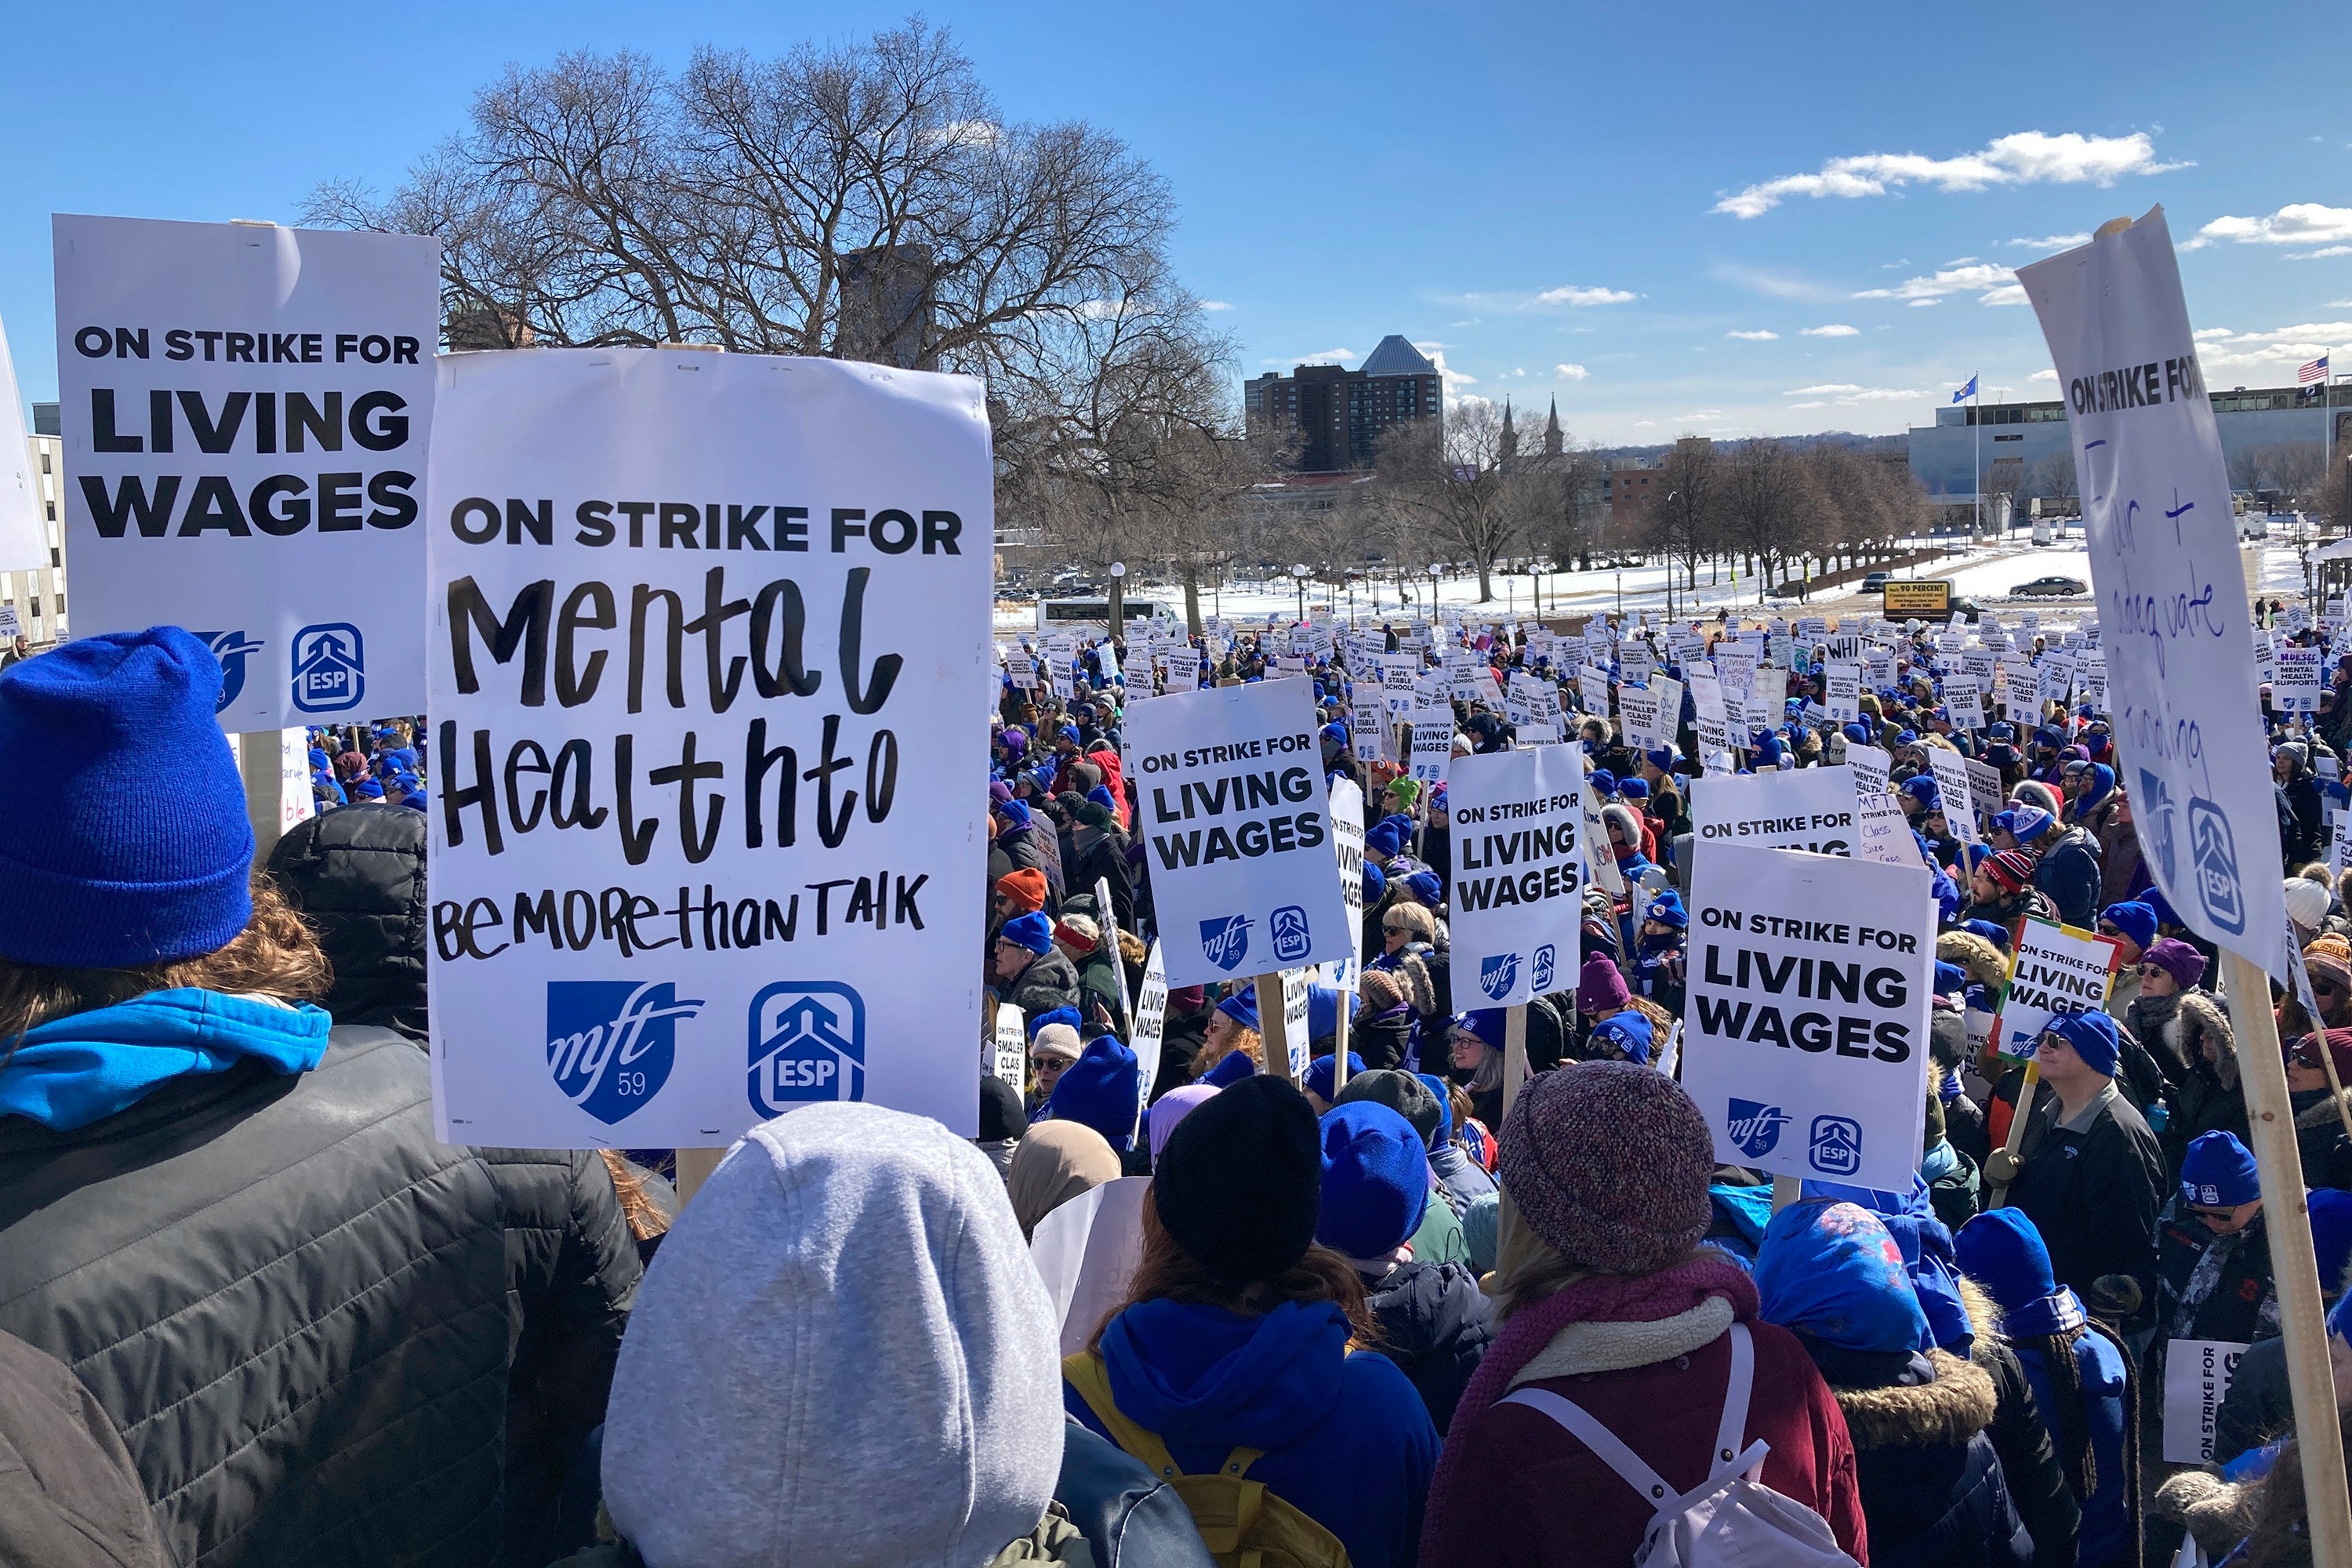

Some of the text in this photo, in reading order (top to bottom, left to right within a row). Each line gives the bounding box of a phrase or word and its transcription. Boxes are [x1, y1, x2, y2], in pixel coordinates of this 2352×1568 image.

[74, 326, 419, 365] ON STRIKE FOR
[2071, 374, 2098, 416] ON
[2096, 361, 2162, 412] STRIKE
[91, 389, 408, 453] LIVING
[78, 471, 418, 538] WAGES
[450, 498, 962, 556] ON STRIKE FOR
[448, 567, 903, 715] Mental
[1053, 665, 1070, 673] LIVING
[1053, 672, 1072, 681] WAGES
[1391, 670, 1409, 678] SAFE,
[308, 670, 347, 690] ESP
[2007, 679, 2038, 690] SMALLER
[2012, 687, 2034, 696] CLASS
[2013, 694, 2033, 703] SIZES
[1621, 703, 1657, 715] SMALLER
[1627, 712, 1653, 721] CLASS
[1356, 717, 1376, 726] STABLE
[1629, 719, 1652, 728] SIZES
[1746, 715, 1766, 724] LIVING
[1414, 731, 1449, 740] LIVING
[1698, 723, 1725, 737] LIVING
[1413, 742, 1449, 753] WAGES
[1699, 734, 1727, 747] WAGES
[1142, 733, 1312, 774] ON STRIKE FOR
[1712, 765, 1726, 774] STRIKE
[1853, 770, 1883, 786] MENTAL
[1858, 763, 1889, 778] STRIKE FOR
[1939, 765, 1966, 778] STRIKE FOR
[1934, 771, 1968, 790] SMALLER
[1968, 772, 1998, 789] IVING
[435, 713, 899, 866] Health to
[1152, 767, 1312, 824] LIVING
[1941, 784, 1965, 800] CLASS
[1457, 792, 1580, 825] ON STRIKE FOR
[1857, 793, 1890, 811] MFT
[1945, 796, 1965, 811] SIZES
[1861, 809, 1888, 819] STRIKE
[1340, 820, 1357, 837] STRIKE
[1701, 812, 1853, 840] ON STRIKE FOR
[1862, 824, 1892, 838] Class
[1152, 812, 1325, 870] WAGES
[1461, 821, 1576, 871] LIVING
[1862, 842, 1885, 854] Size
[1337, 843, 1362, 876] IVING
[1457, 861, 1579, 913] WAGES
[2206, 868, 2231, 900] ESP
[1700, 907, 1918, 955] ON STRIKE FOR
[1282, 934, 1301, 949] ESP
[1229, 949, 1240, 961] 59
[2019, 943, 2111, 978] ON STRIKE FOR
[1535, 968, 1549, 980] ESP
[1704, 943, 1907, 1010] LIVING
[2014, 960, 2103, 1001] LIVING
[1499, 984, 1508, 993] 59
[1141, 989, 1164, 1013] LIVING
[1693, 994, 1911, 1064] WAGES
[778, 1058, 836, 1088] ESP
[617, 1071, 647, 1097] 59
[1755, 1138, 1767, 1151] 59
[1821, 1145, 1849, 1162] ESP
[2201, 1347, 2215, 1461] ON STRIKE FOR
